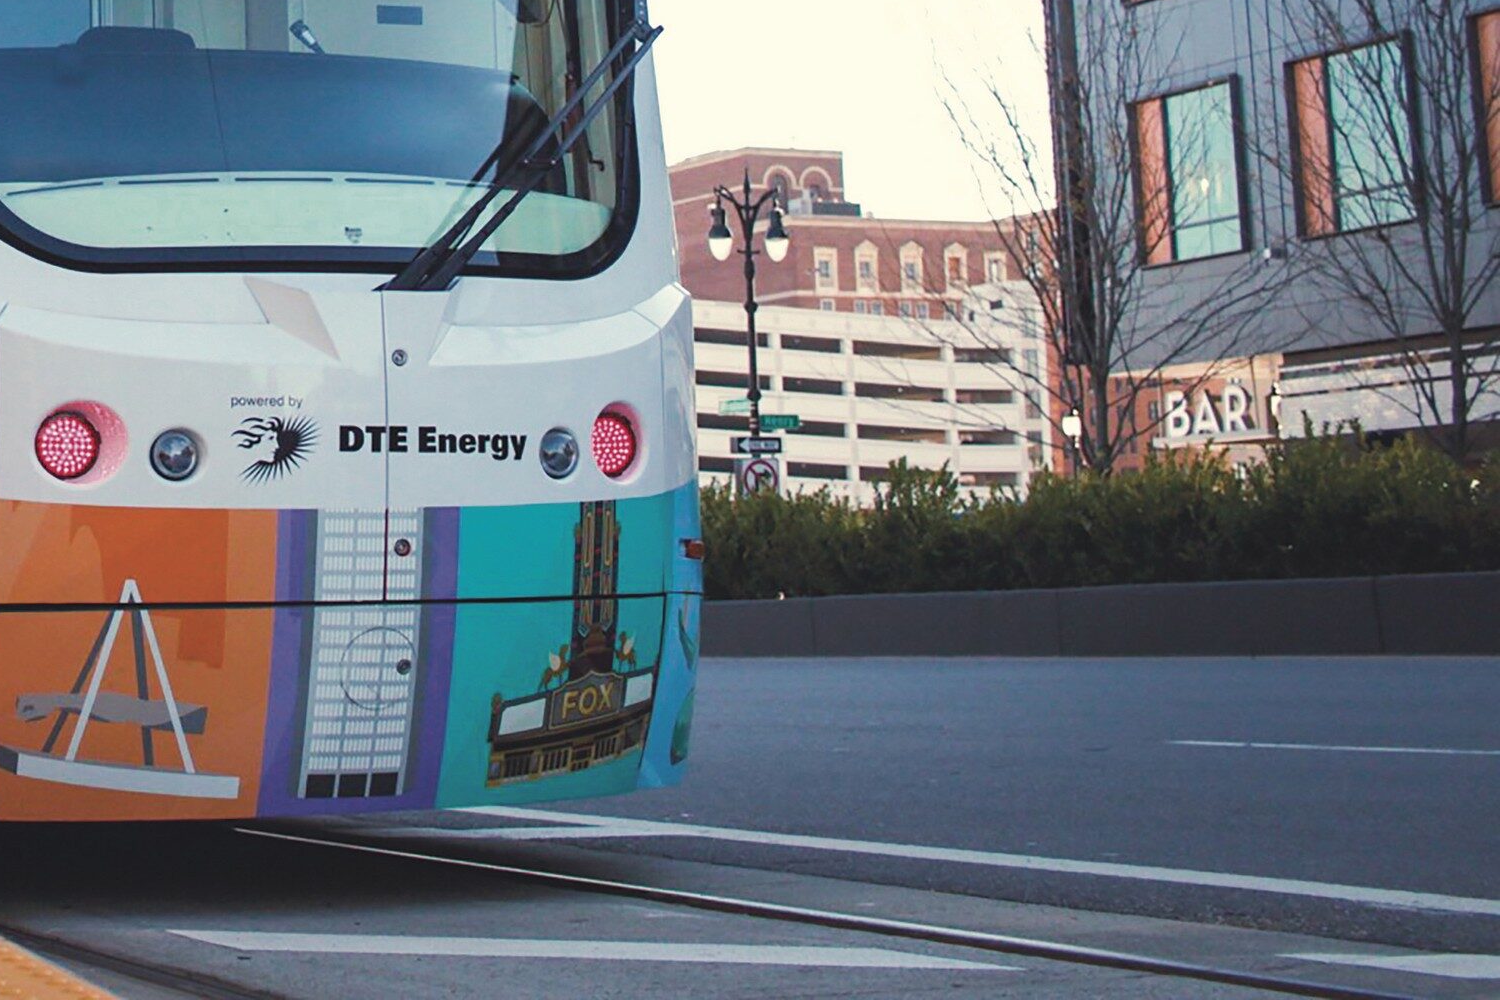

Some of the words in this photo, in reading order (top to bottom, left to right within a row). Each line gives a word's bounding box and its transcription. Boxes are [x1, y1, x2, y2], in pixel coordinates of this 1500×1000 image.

[230, 395, 284, 408] powered
[288, 394, 303, 409] by
[1164, 384, 1250, 437] BAR
[338, 424, 409, 453] DTE
[418, 425, 528, 461] Energy
[561, 681, 614, 720] FOX
